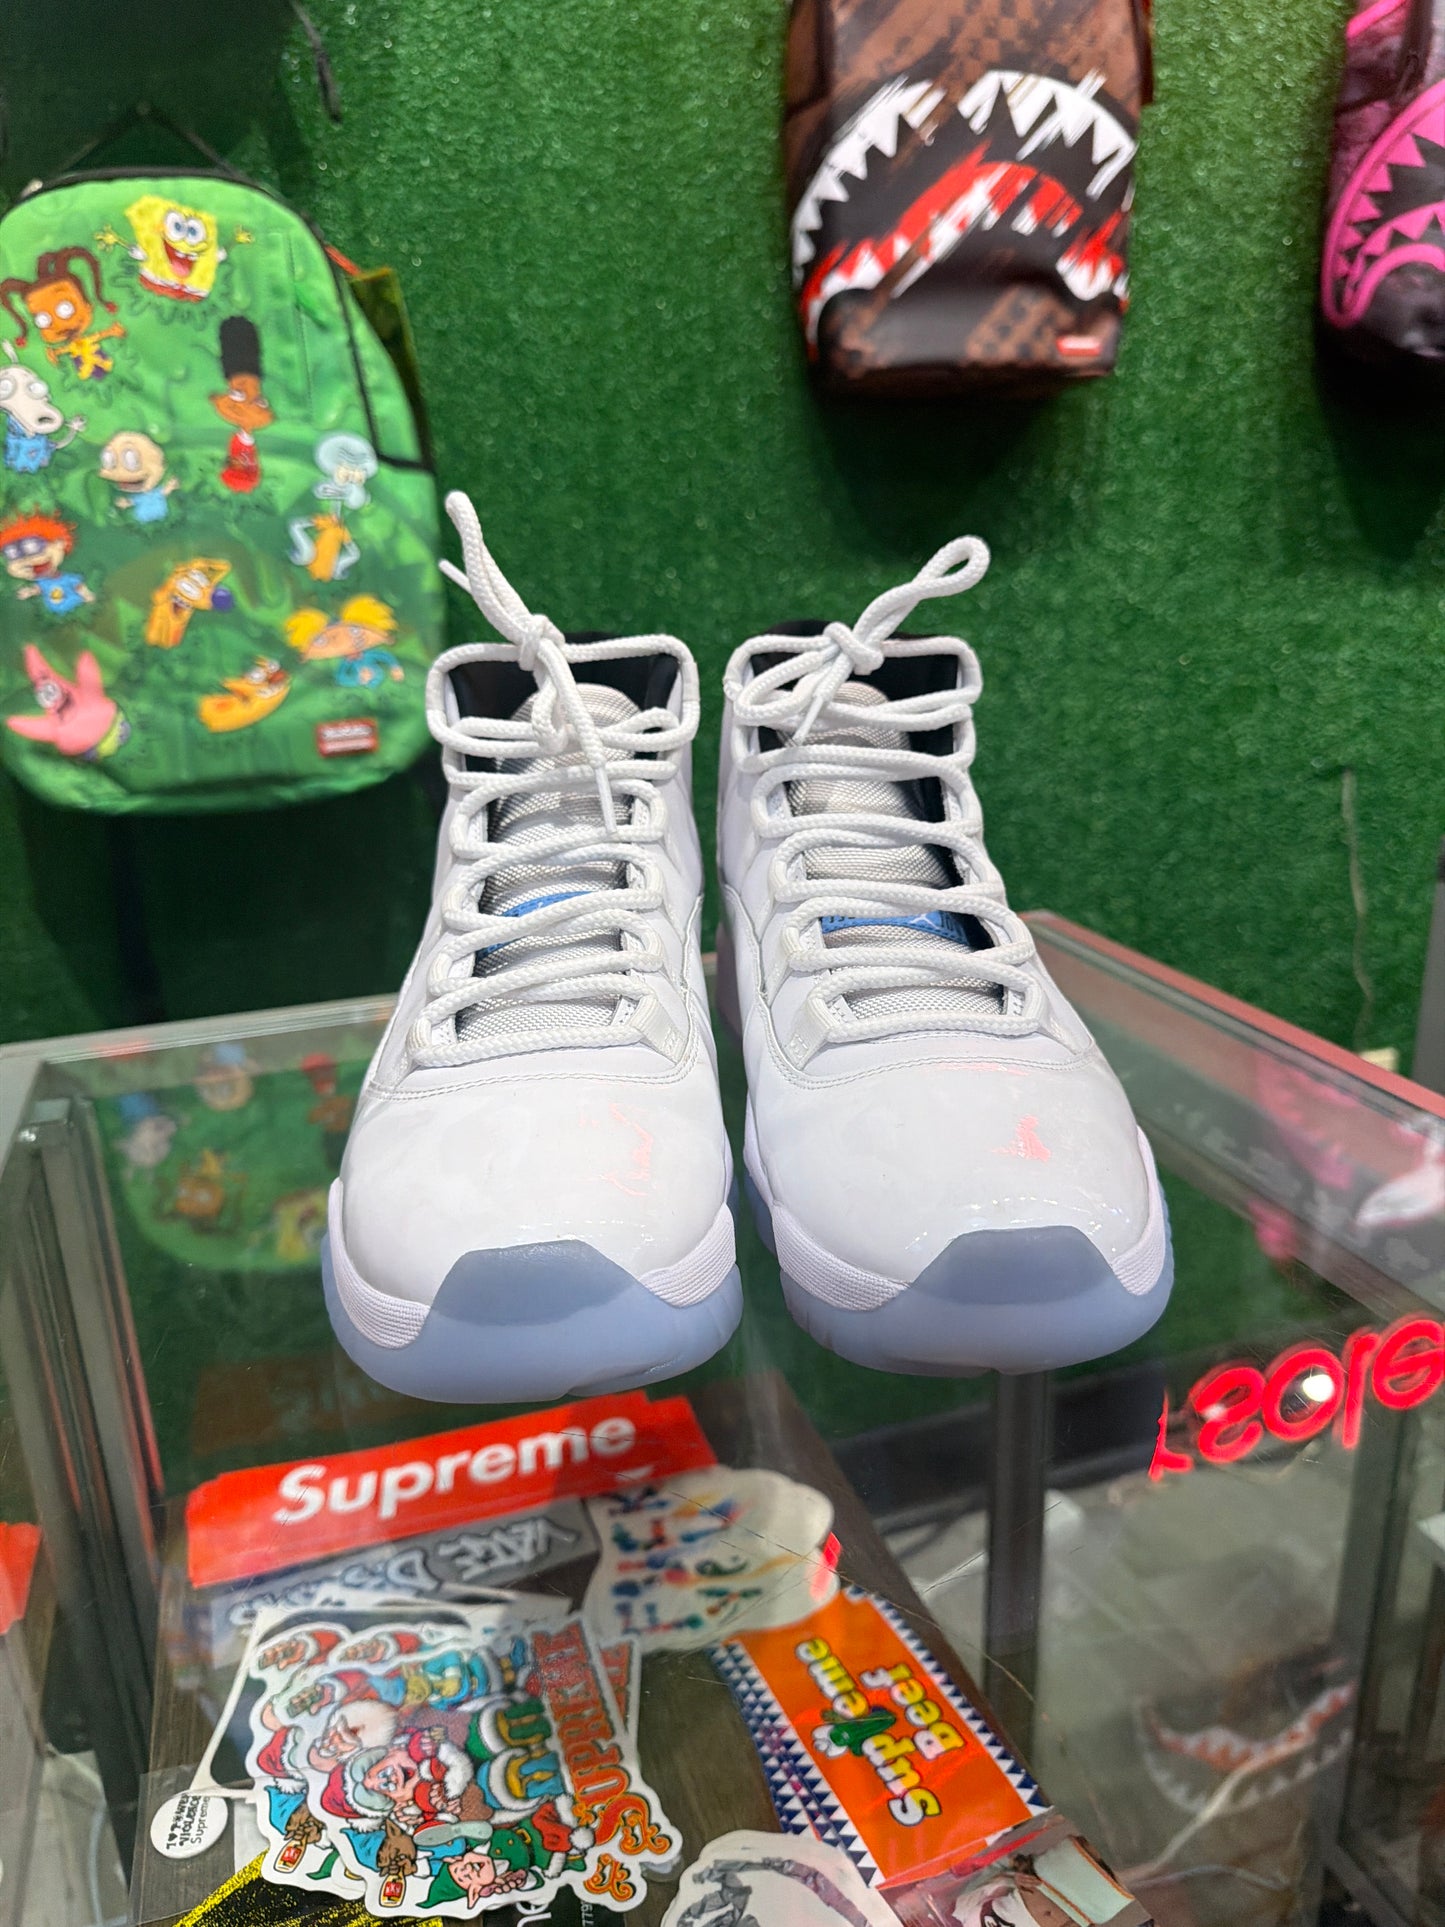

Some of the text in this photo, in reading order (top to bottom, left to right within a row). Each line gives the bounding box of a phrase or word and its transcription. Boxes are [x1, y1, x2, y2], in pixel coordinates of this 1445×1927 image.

[272, 1417, 636, 1525] Supreme
[860, 1664, 966, 1761] Beef
[190, 1796, 211, 1844] Supreme
